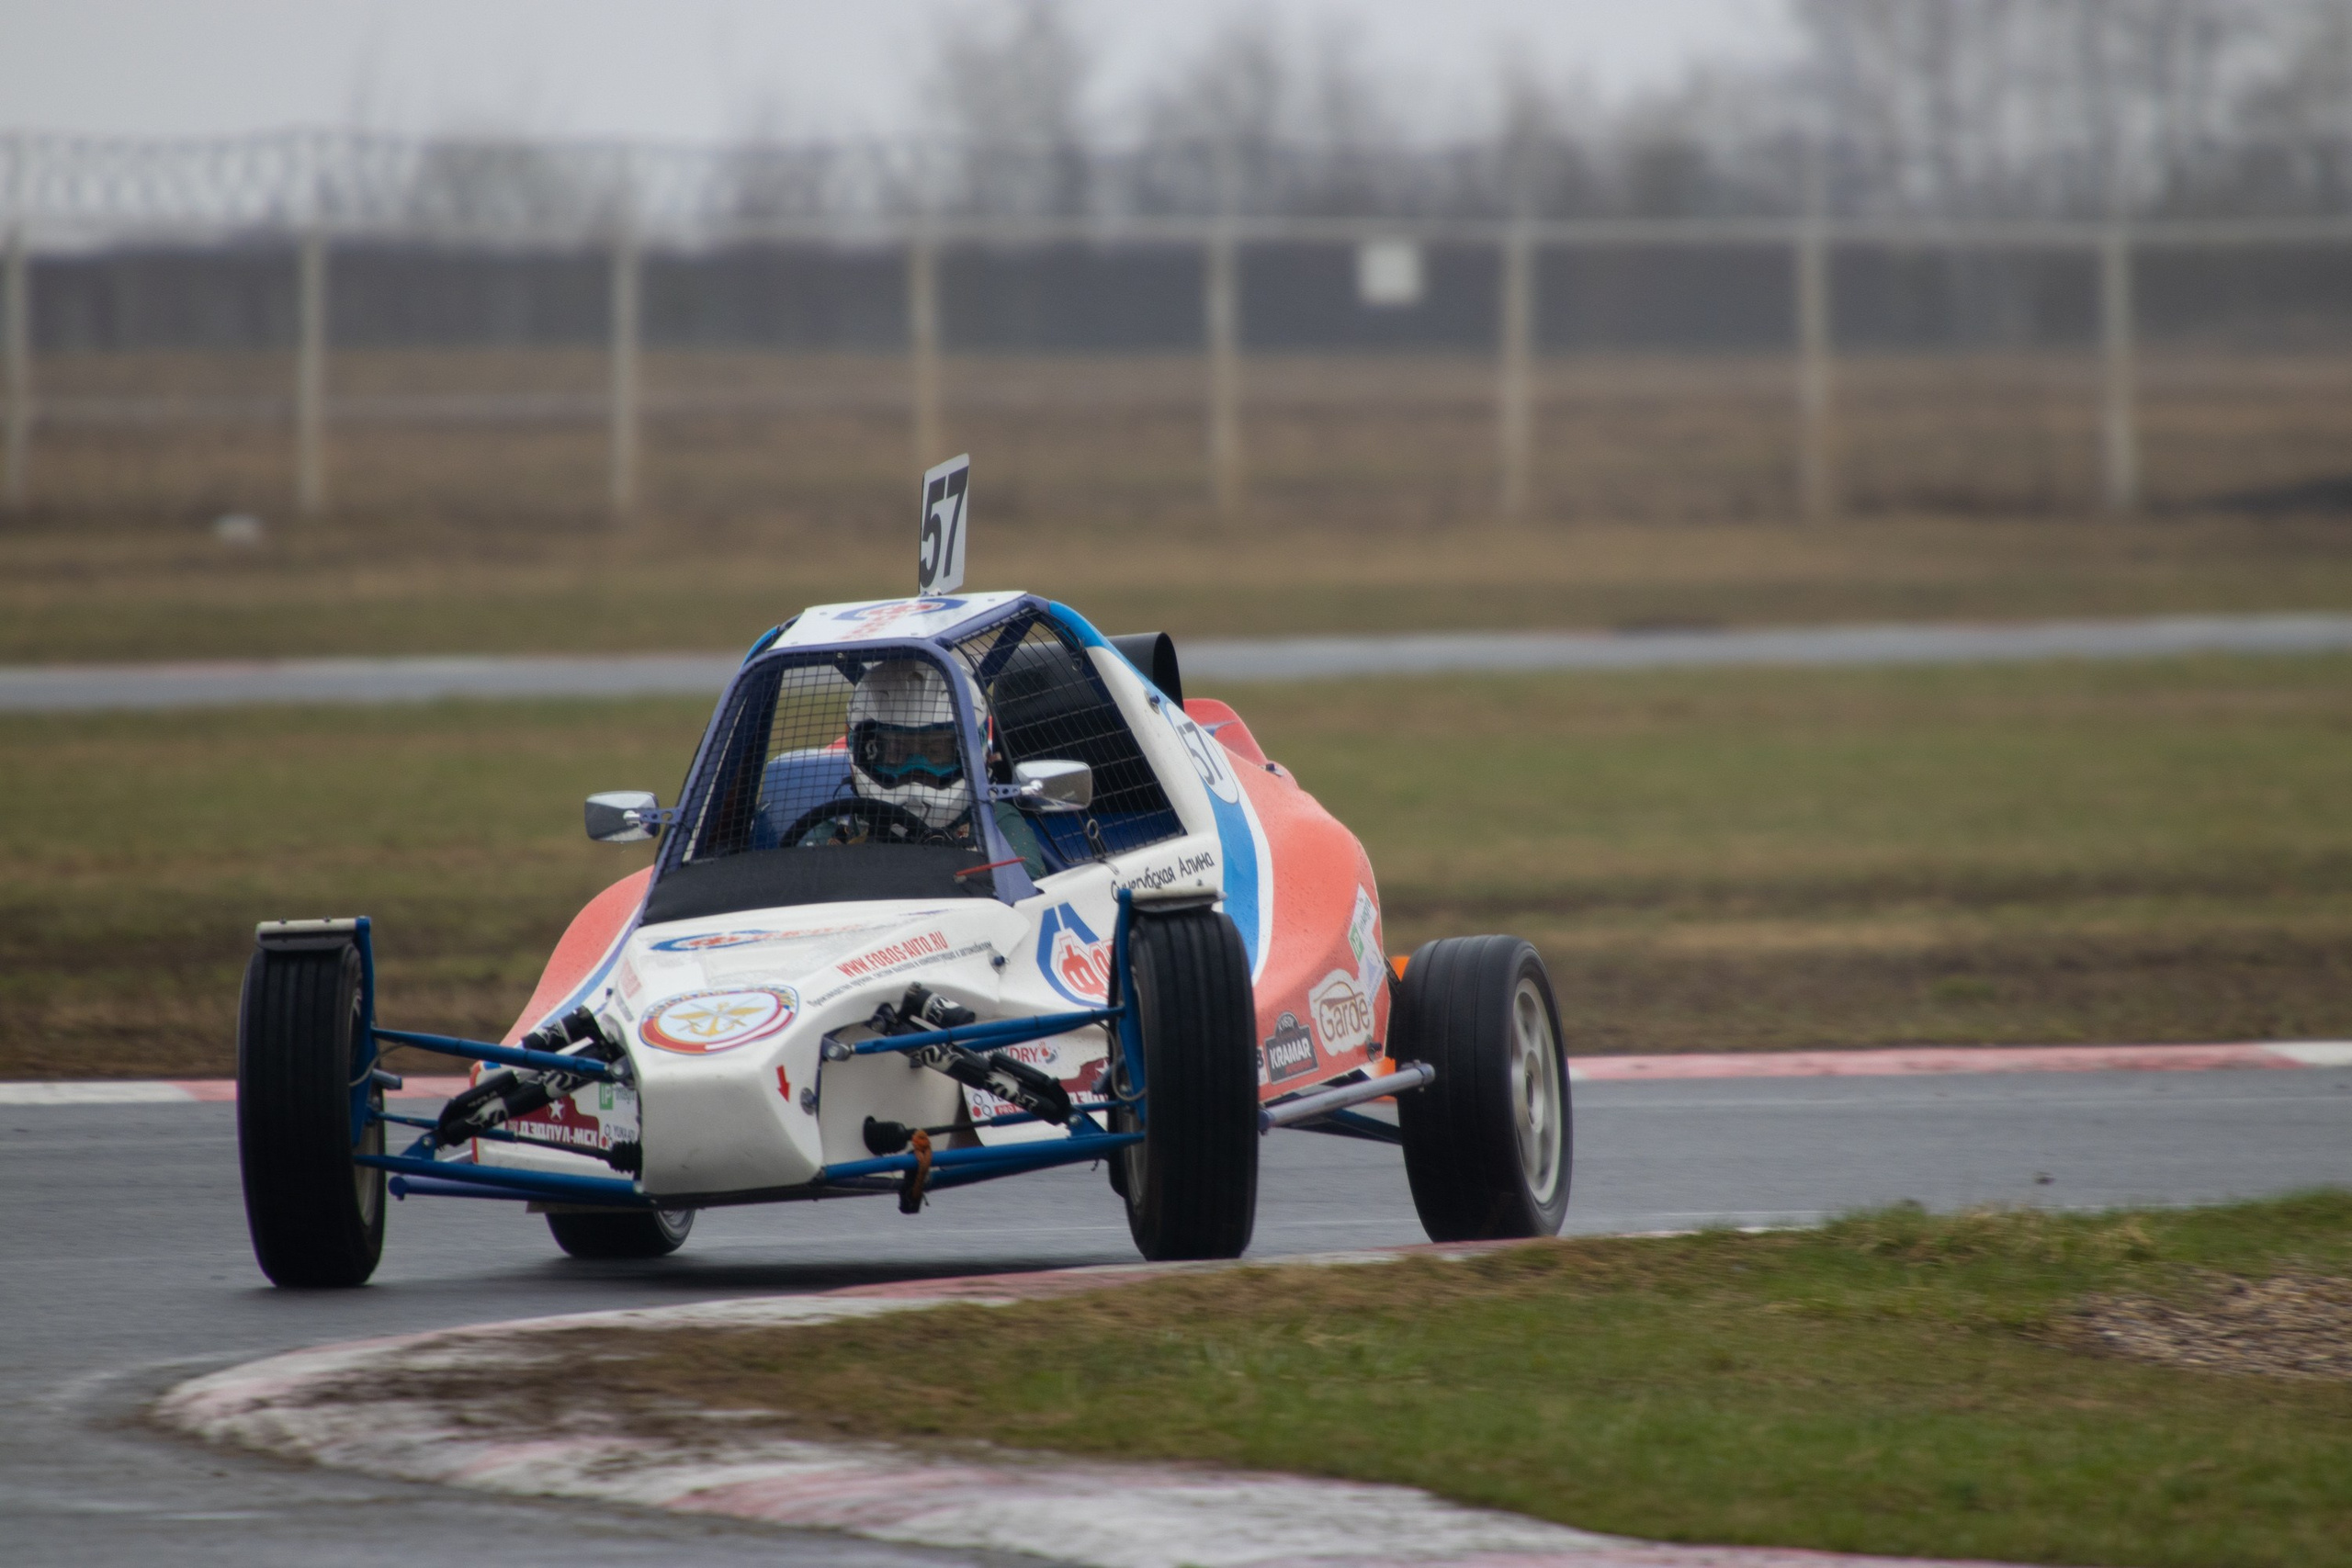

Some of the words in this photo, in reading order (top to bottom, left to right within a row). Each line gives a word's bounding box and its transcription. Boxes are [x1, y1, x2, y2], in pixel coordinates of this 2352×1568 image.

[920, 466, 969, 588] 57
[1177, 720, 1223, 785] 57
[1178, 852, 1215, 877] Алина
[837, 931, 948, 977] WWW.FOBOS-AVTO.RU
[1319, 991, 1370, 1042] Garde
[1270, 1038, 1311, 1069] KRAMAR
